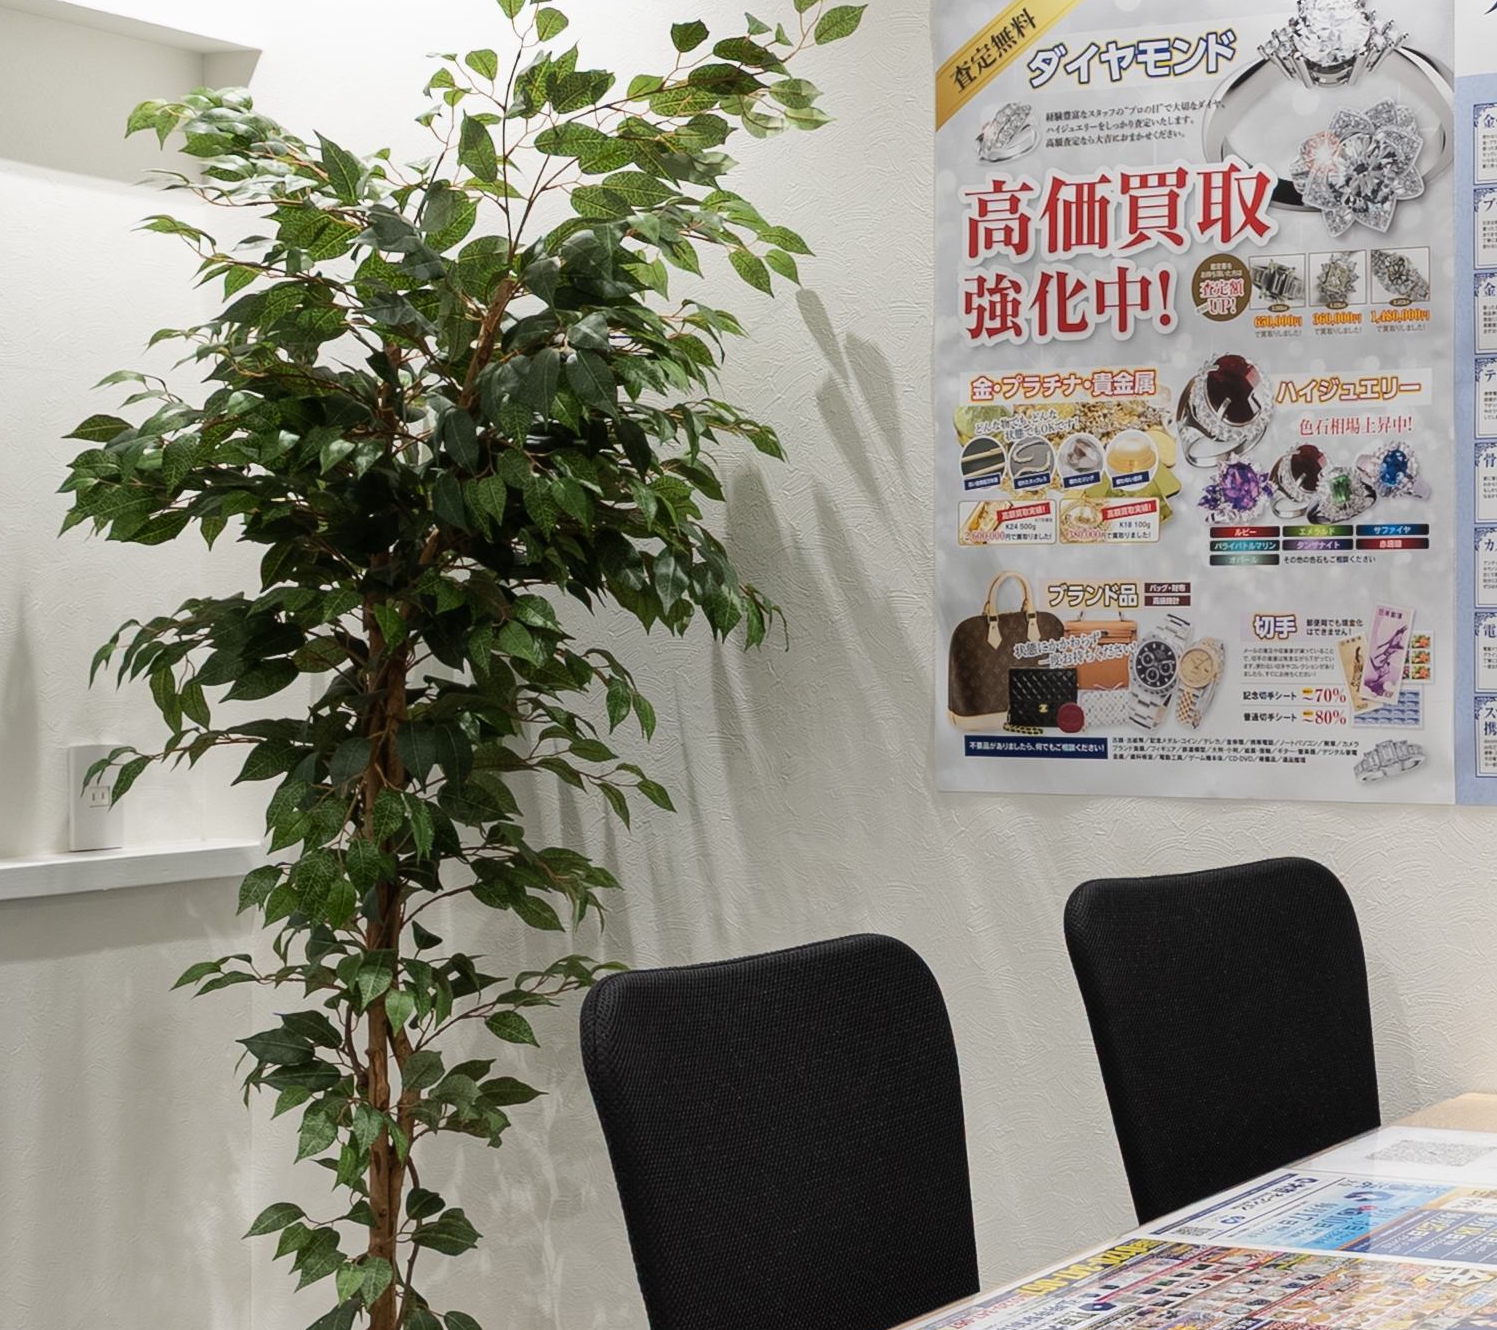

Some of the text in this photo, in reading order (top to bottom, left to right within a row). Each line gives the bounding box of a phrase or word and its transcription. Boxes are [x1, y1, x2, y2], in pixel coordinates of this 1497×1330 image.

[951, 8, 1037, 93] 査定無料
[1028, 29, 1237, 89] ダイヤモンド
[963, 162, 1273, 261] 高価買取
[1200, 279, 1244, 297] 査定額
[964, 265, 1172, 341] 強化中!
[1208, 299, 1237, 314] UP!
[971, 370, 1156, 401] 金・プラチナ・貴金属
[1276, 376, 1422, 404] ハイジュエリー
[1005, 417, 1080, 440] 状態でもOKです!
[1300, 416, 1412, 436] 色石相場上昇中!
[1020, 523, 1036, 531] 500g
[1134, 522, 1151, 530] 100g
[1234, 528, 1256, 536] ルビー
[1299, 527, 1335, 536] エメラルド
[1374, 526, 1411, 534] サファイヤ
[1048, 583, 1138, 608] ブランド品
[1254, 615, 1297, 640] 切手
[1306, 628, 1352, 636] はできません!
[1014, 630, 1102, 659] 状態にかかわらず
[1243, 692, 1297, 700] 記念切手シート
[1244, 713, 1297, 722] 普通切手シート
